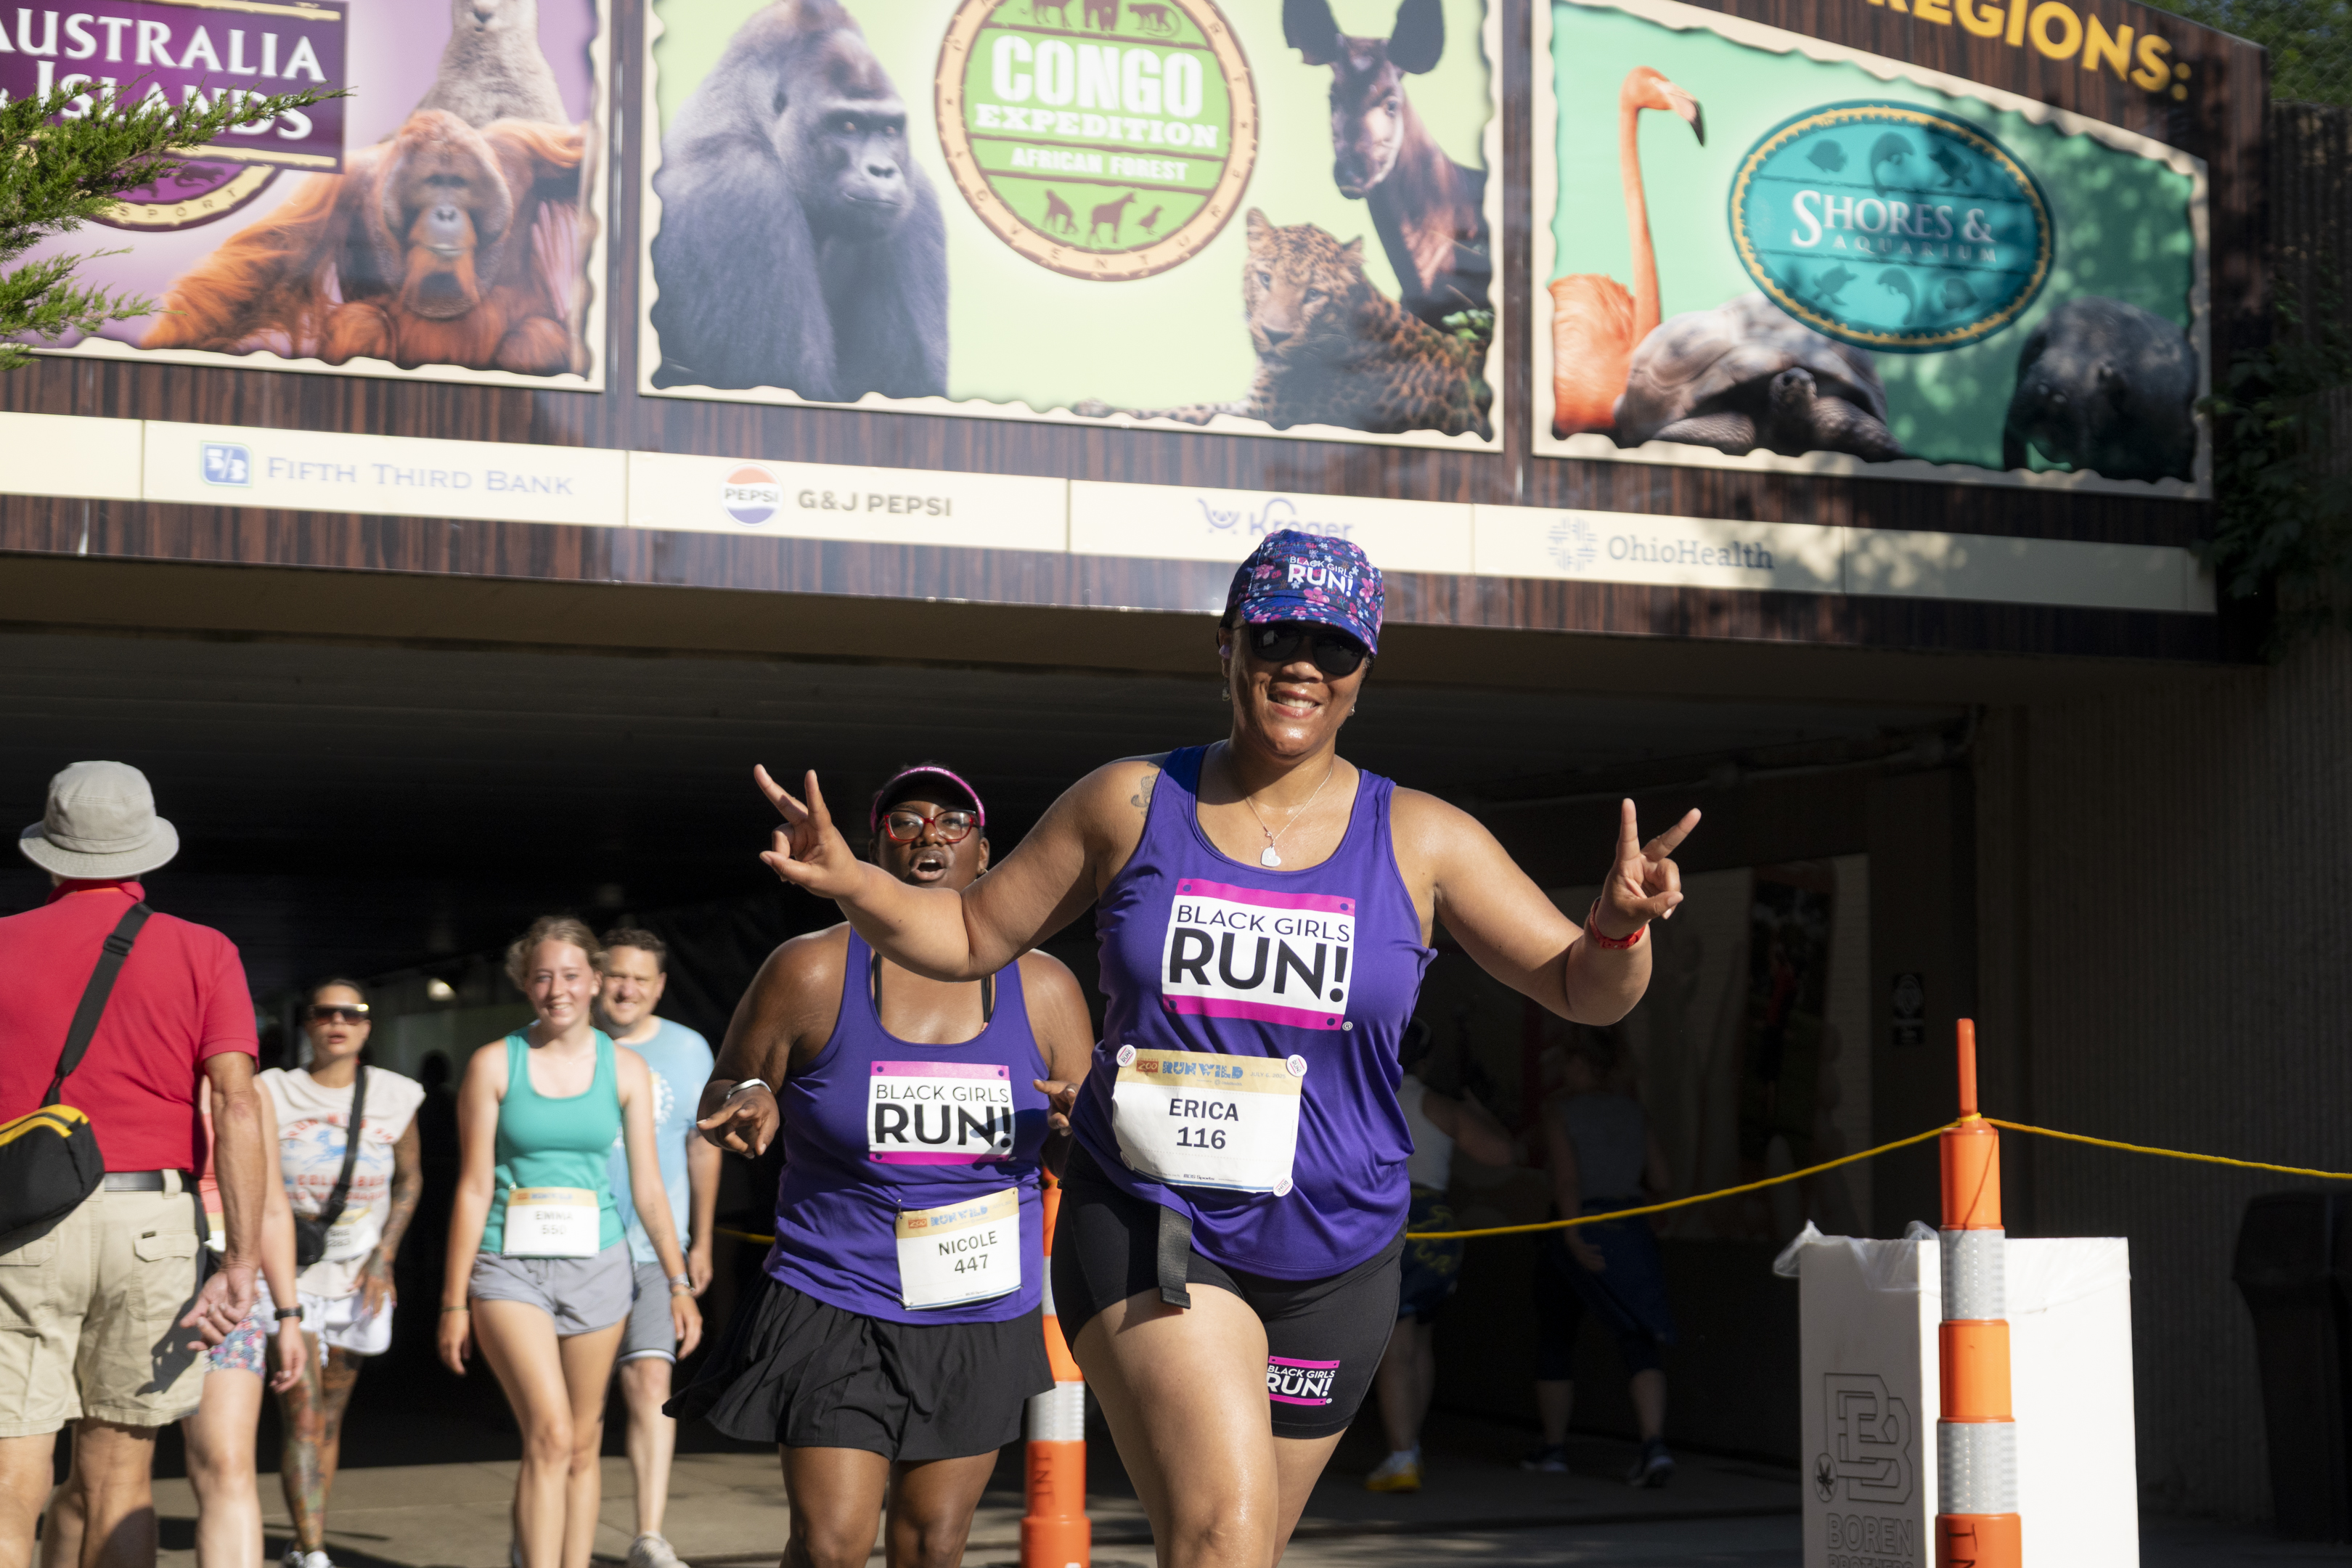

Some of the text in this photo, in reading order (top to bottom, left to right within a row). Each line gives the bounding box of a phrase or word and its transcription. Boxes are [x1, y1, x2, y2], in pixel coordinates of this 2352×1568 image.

[992, 35, 1203, 118] CONGO
[975, 103, 1219, 149] EXPEDITION
[1011, 147, 1189, 181] AFRICAN FOREST
[1791, 189, 1996, 248] SHORES &
[1833, 234, 1996, 263] AQUARIUM
[266, 456, 574, 496] FIFTH THIRD BANK
[724, 488, 779, 503] PEPSI
[799, 489, 952, 517] G&J PEPSI
[1608, 535, 1775, 569] OhioHealth
[1287, 563, 1355, 597] RUN!
[1289, 556, 1354, 579] BLACK GIRLS
[1177, 904, 1350, 942] BLACK GIRLS
[1168, 927, 1349, 1003] RUN!
[1162, 1061, 1244, 1079] RUN WILD
[876, 1084, 1010, 1103] BLACK GIRLS
[1169, 1098, 1239, 1122] ERICA
[874, 1102, 1012, 1148] RUN!
[1176, 1127, 1227, 1150] 116
[931, 1212, 957, 1227] RUN
[939, 1230, 998, 1256] NICOLE
[954, 1254, 989, 1274] 447
[1266, 1372, 1333, 1397] RUN!
[1267, 1365, 1336, 1379] BLACK GIRLS
[1827, 1512, 1914, 1557] BOREN
